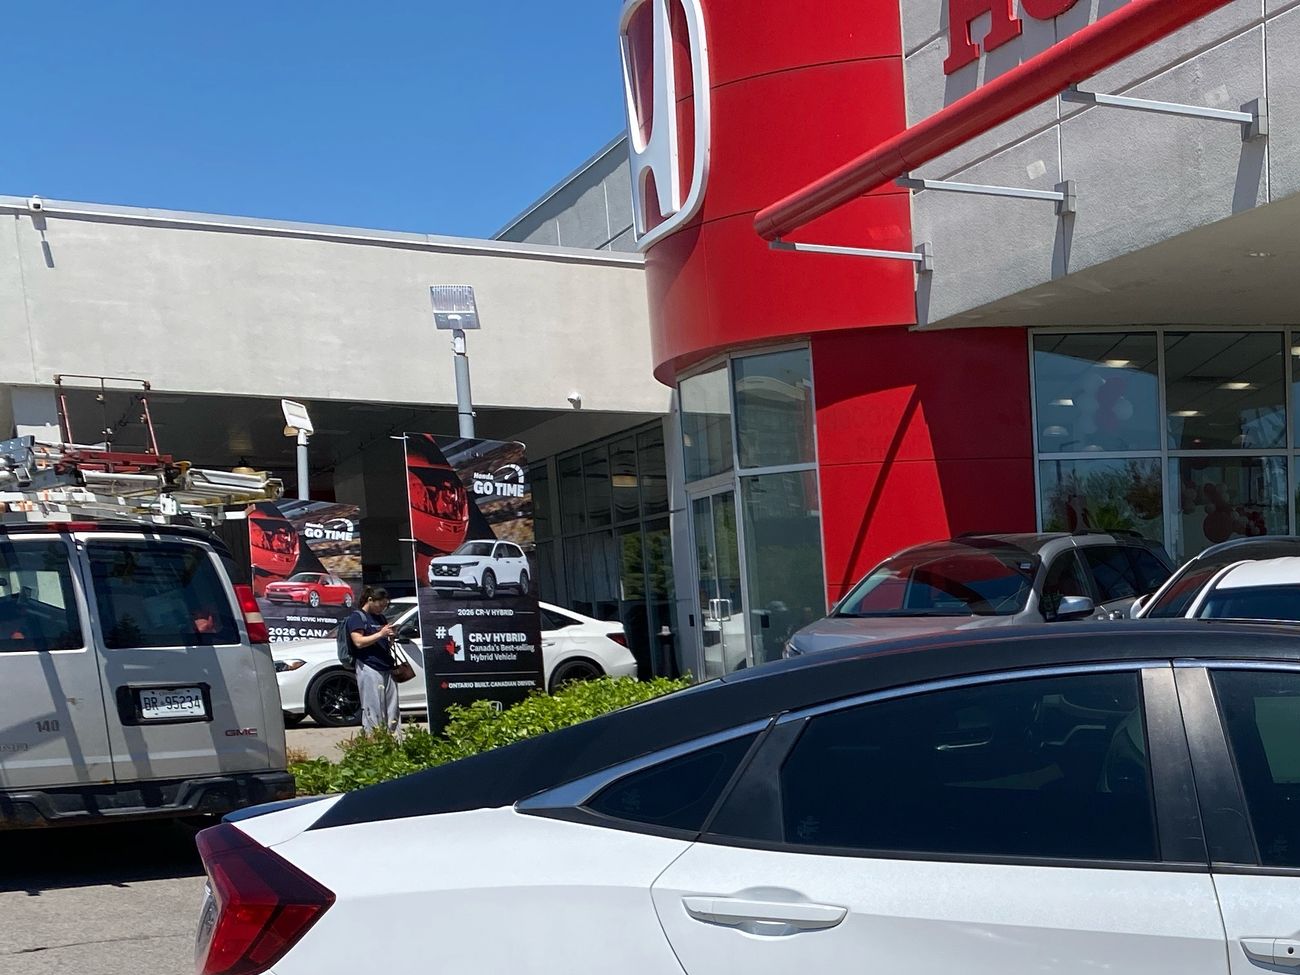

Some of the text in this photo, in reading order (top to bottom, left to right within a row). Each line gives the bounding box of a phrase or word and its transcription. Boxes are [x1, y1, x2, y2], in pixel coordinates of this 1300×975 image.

[473, 472, 494, 480] Honda
[473, 481, 525, 497] GO TIME
[304, 528, 353, 541] GO TIME
[268, 627, 329, 637] 2026 CANA
[468, 632, 527, 643] CR-V HYBRID
[469, 643, 535, 653] Canada's Best-selling
[470, 653, 494, 662] Hybrid
[165, 695, 201, 710] 95234
[36, 719, 60, 733] 140
[224, 728, 258, 737] GMC
